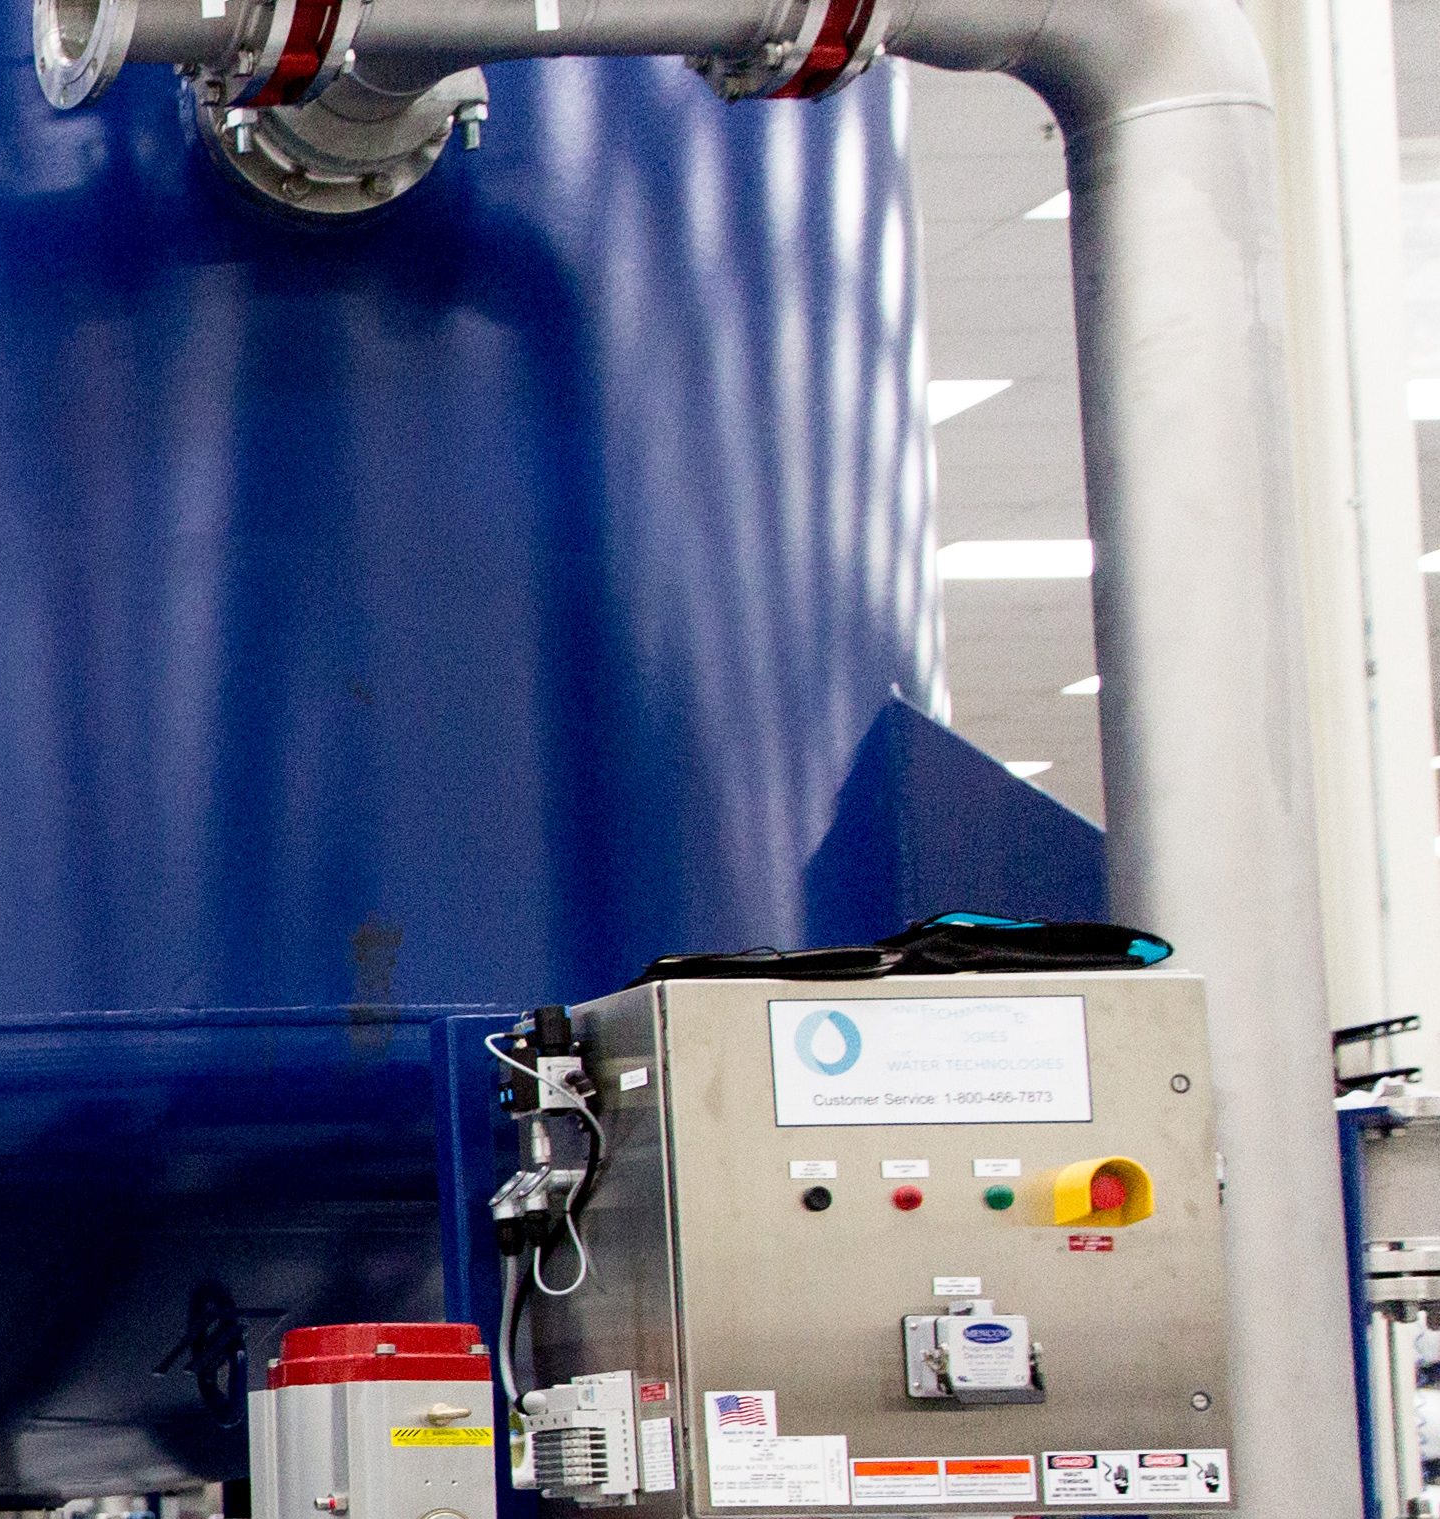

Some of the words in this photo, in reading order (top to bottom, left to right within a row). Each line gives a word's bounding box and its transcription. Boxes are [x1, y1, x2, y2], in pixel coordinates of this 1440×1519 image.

[887, 1059, 939, 1073] WATER
[945, 1057, 1065, 1071] TECHNOLOGIES
[813, 1093, 880, 1106] Customer
[884, 1092, 936, 1106] Service:
[944, 1091, 1054, 1105] 1-800-466-7873
